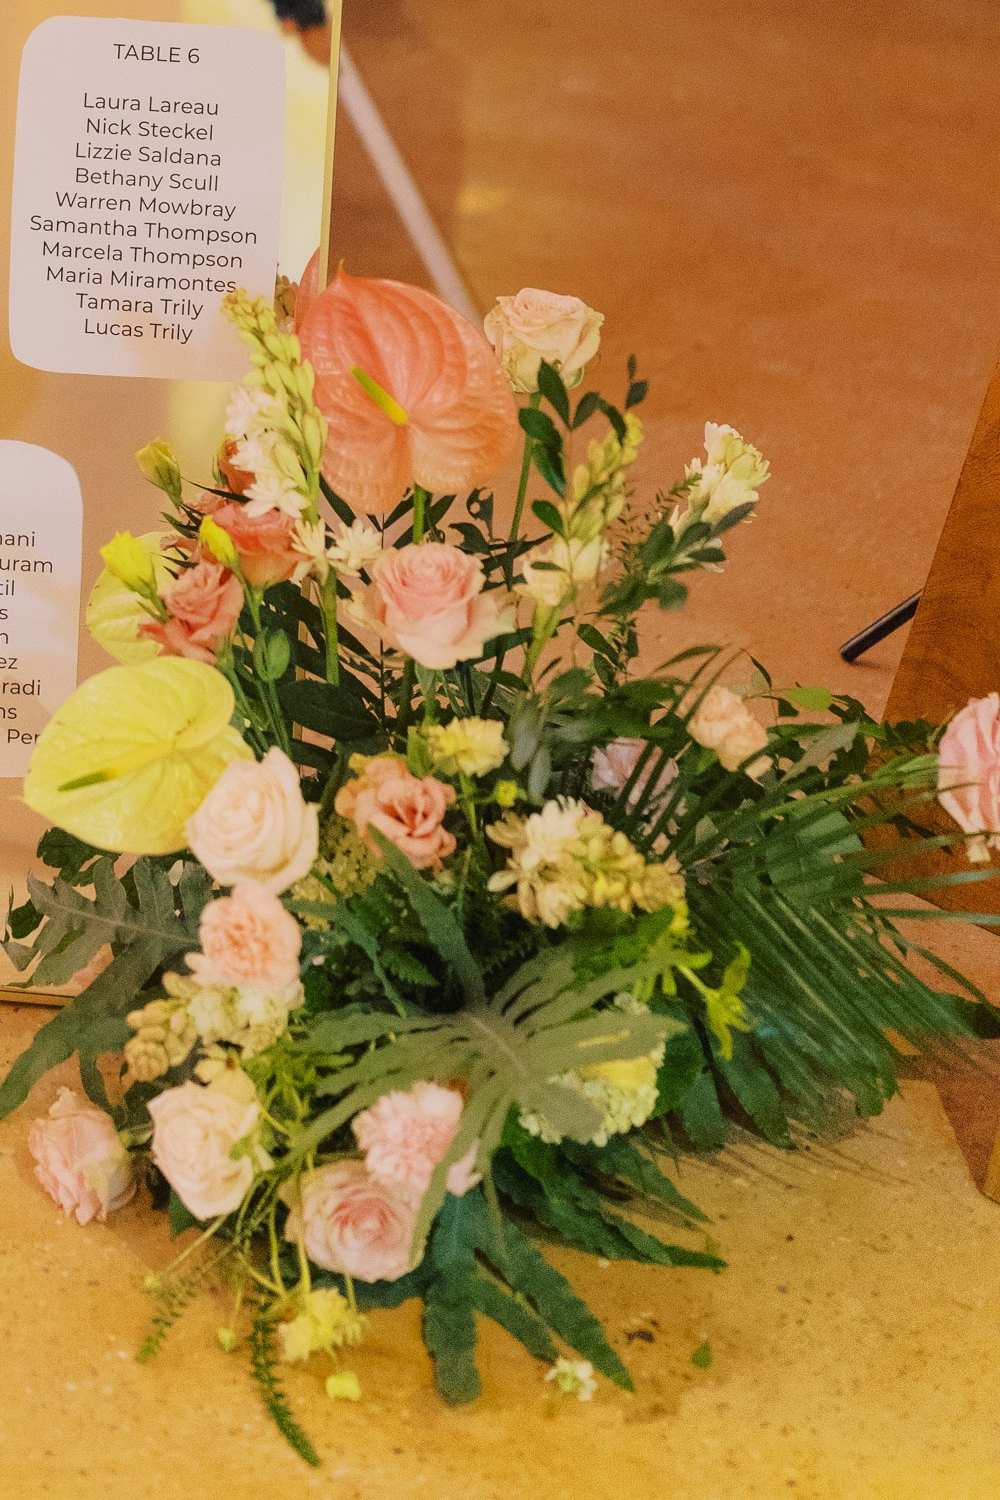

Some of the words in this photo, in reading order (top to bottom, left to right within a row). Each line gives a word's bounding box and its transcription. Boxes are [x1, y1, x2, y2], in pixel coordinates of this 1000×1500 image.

[112, 42, 182, 64] TABLE
[187, 47, 201, 65] 6
[83, 91, 142, 112] Laura
[148, 95, 219, 117] Lareau
[85, 117, 133, 137] Nick
[137, 120, 214, 142] Steckel
[75, 141, 133, 162] Lizzie
[137, 145, 222, 167] Saldana
[74, 166, 164, 193] Bethany
[168, 172, 219, 193] Scull
[54, 190, 132, 212] Warren
[138, 195, 237, 223] Mowbray
[29, 214, 138, 238] Samantha
[143, 221, 258, 247] Thompson
[41, 240, 124, 262] Marcela
[128, 245, 243, 271] Thompson
[46, 265, 103, 286] Maria
[110, 269, 237, 294] Miramontes
[74, 291, 154, 314] Tamara
[159, 297, 205, 321] Trily
[84, 317, 144, 339] Lucas
[148, 322, 194, 346] Trily
